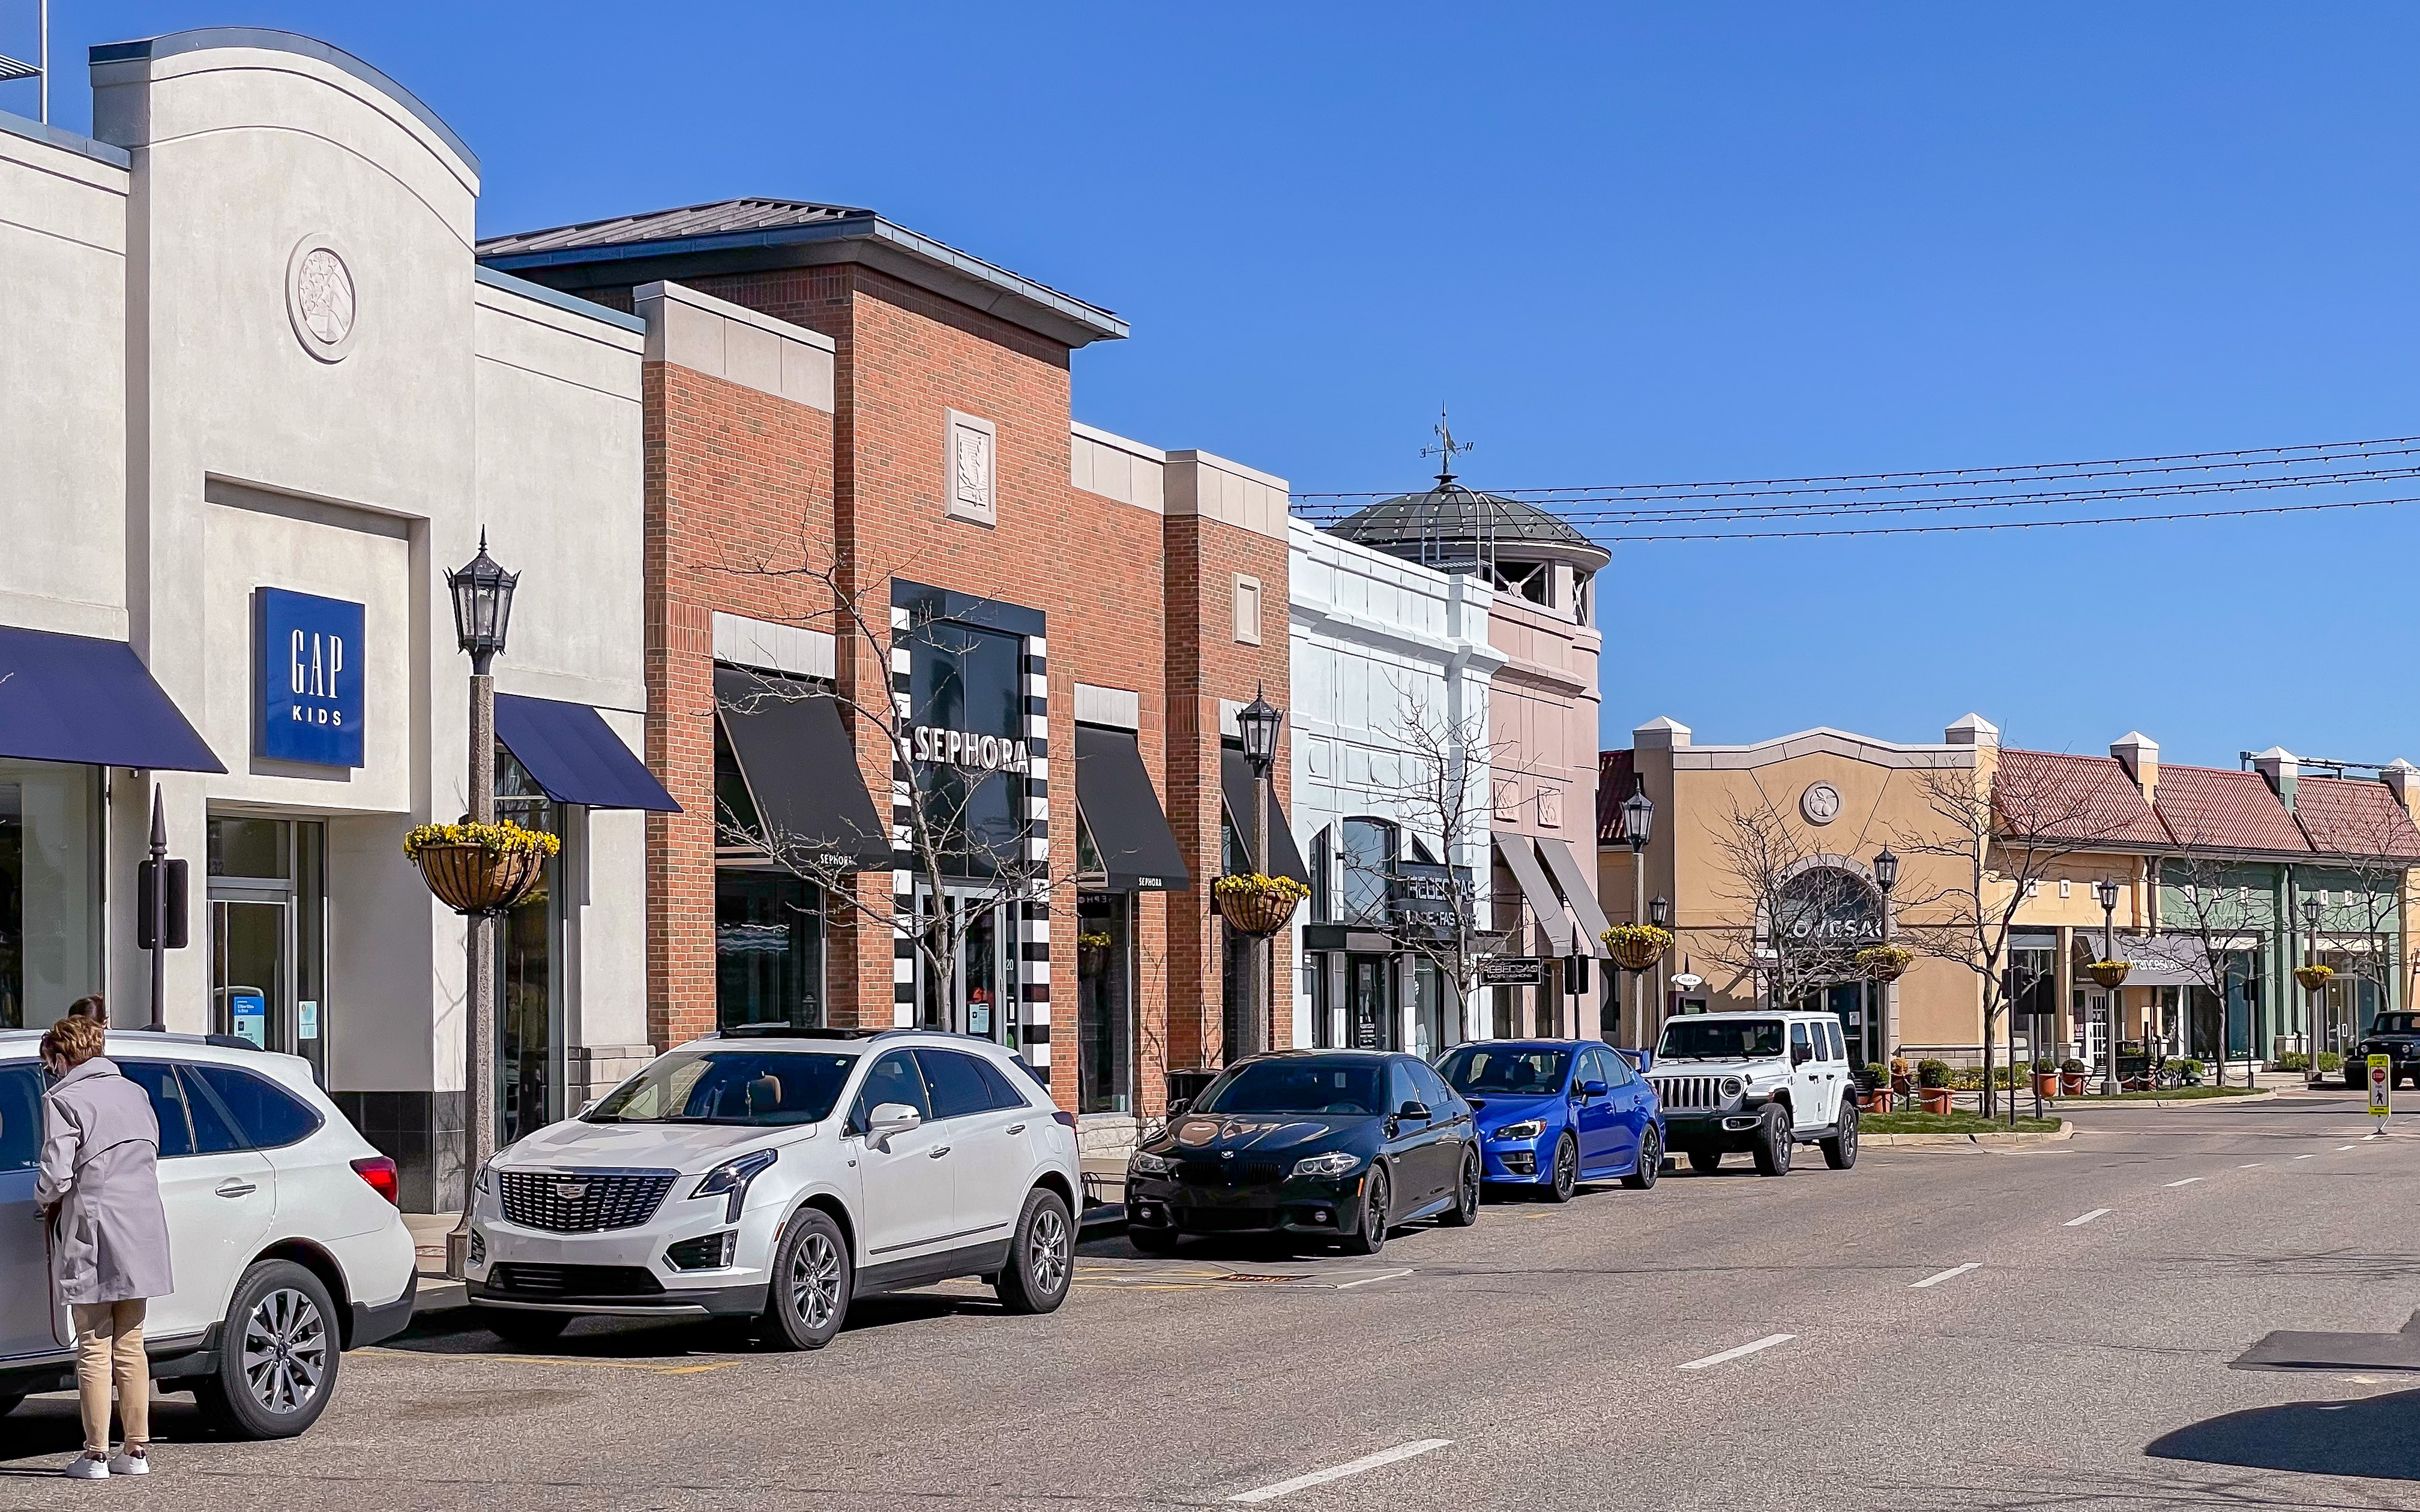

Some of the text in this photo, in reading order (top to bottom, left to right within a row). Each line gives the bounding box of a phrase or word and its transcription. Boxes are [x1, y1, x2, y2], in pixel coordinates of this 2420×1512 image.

[292, 629, 343, 698] GAP
[292, 705, 342, 726] KIDS
[915, 725, 1029, 774] SEPHORA
[1139, 877, 1162, 887] SEPHORA
